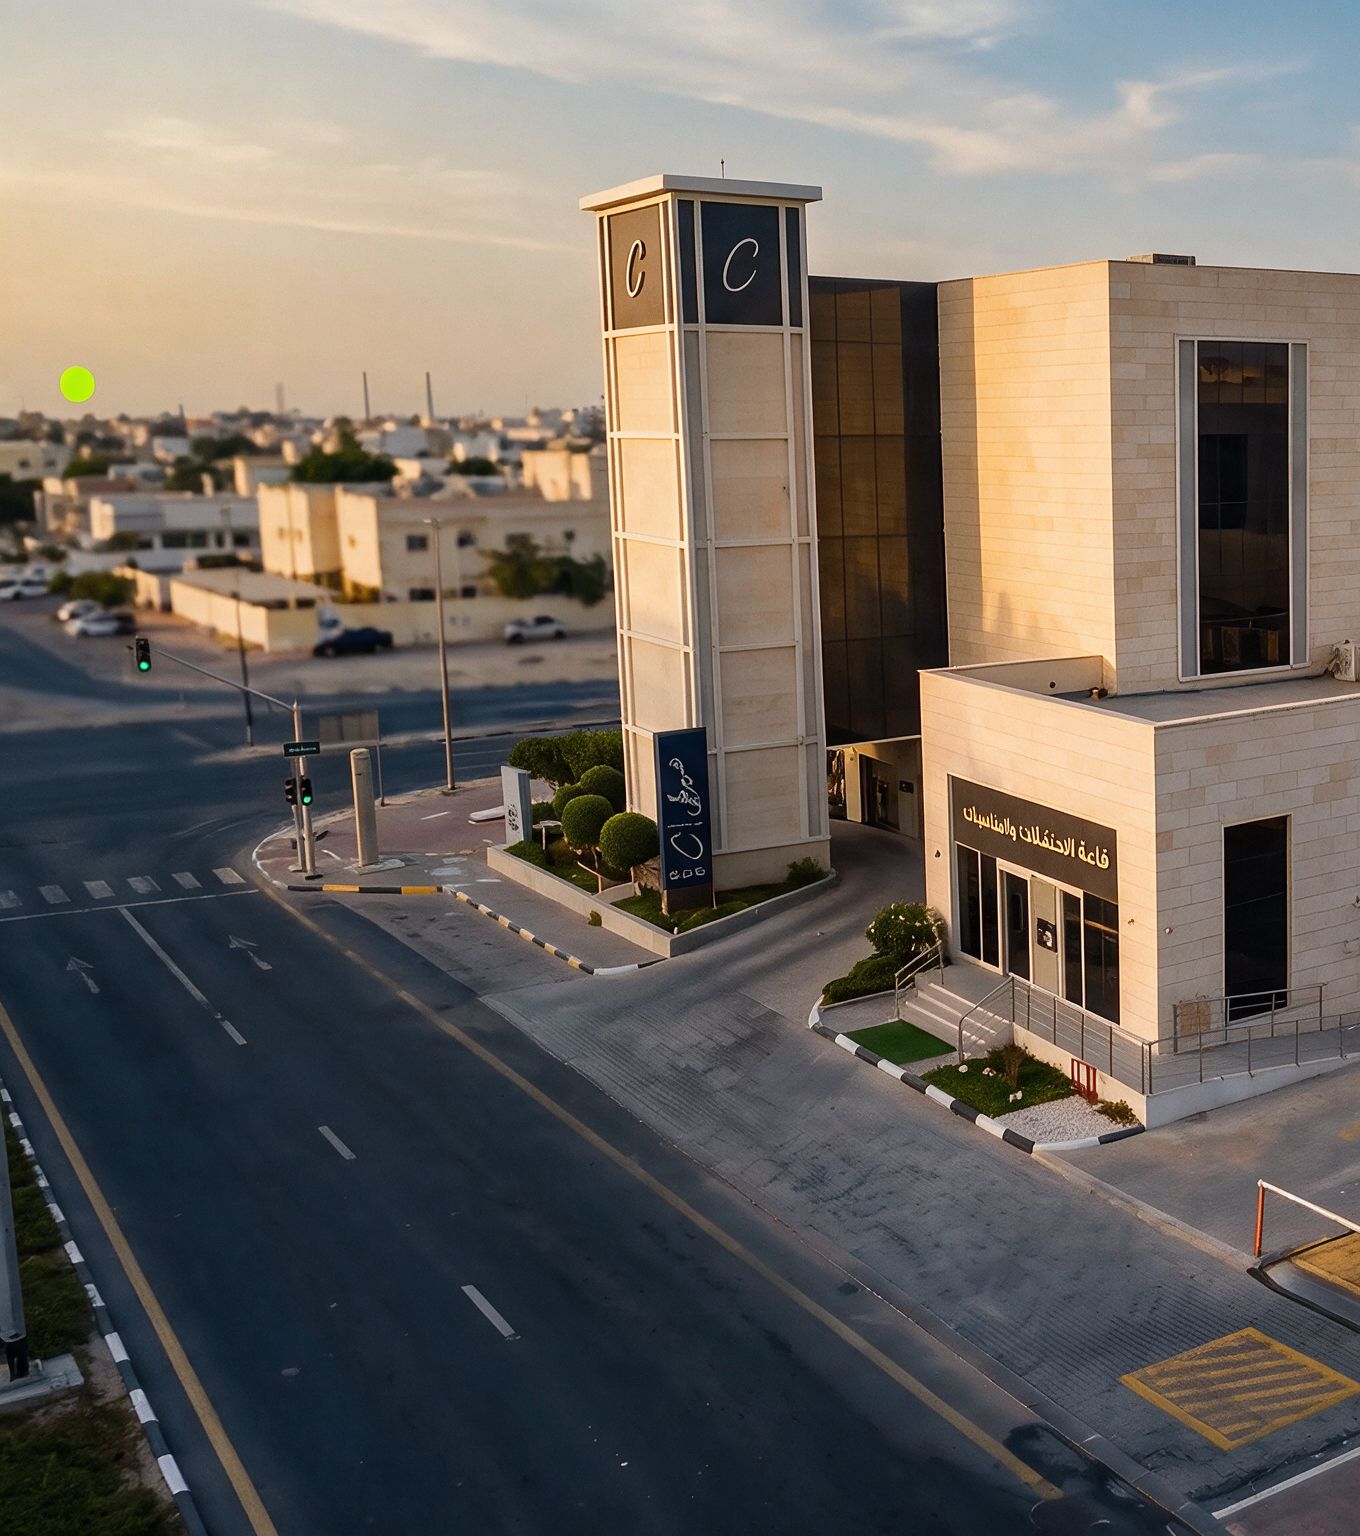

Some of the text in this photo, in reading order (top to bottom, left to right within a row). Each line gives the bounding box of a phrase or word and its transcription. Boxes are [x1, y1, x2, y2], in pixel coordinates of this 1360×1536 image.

[625, 238, 646, 298] C
[722, 237, 759, 293] C
[1077, 840, 1110, 869] قاعة
